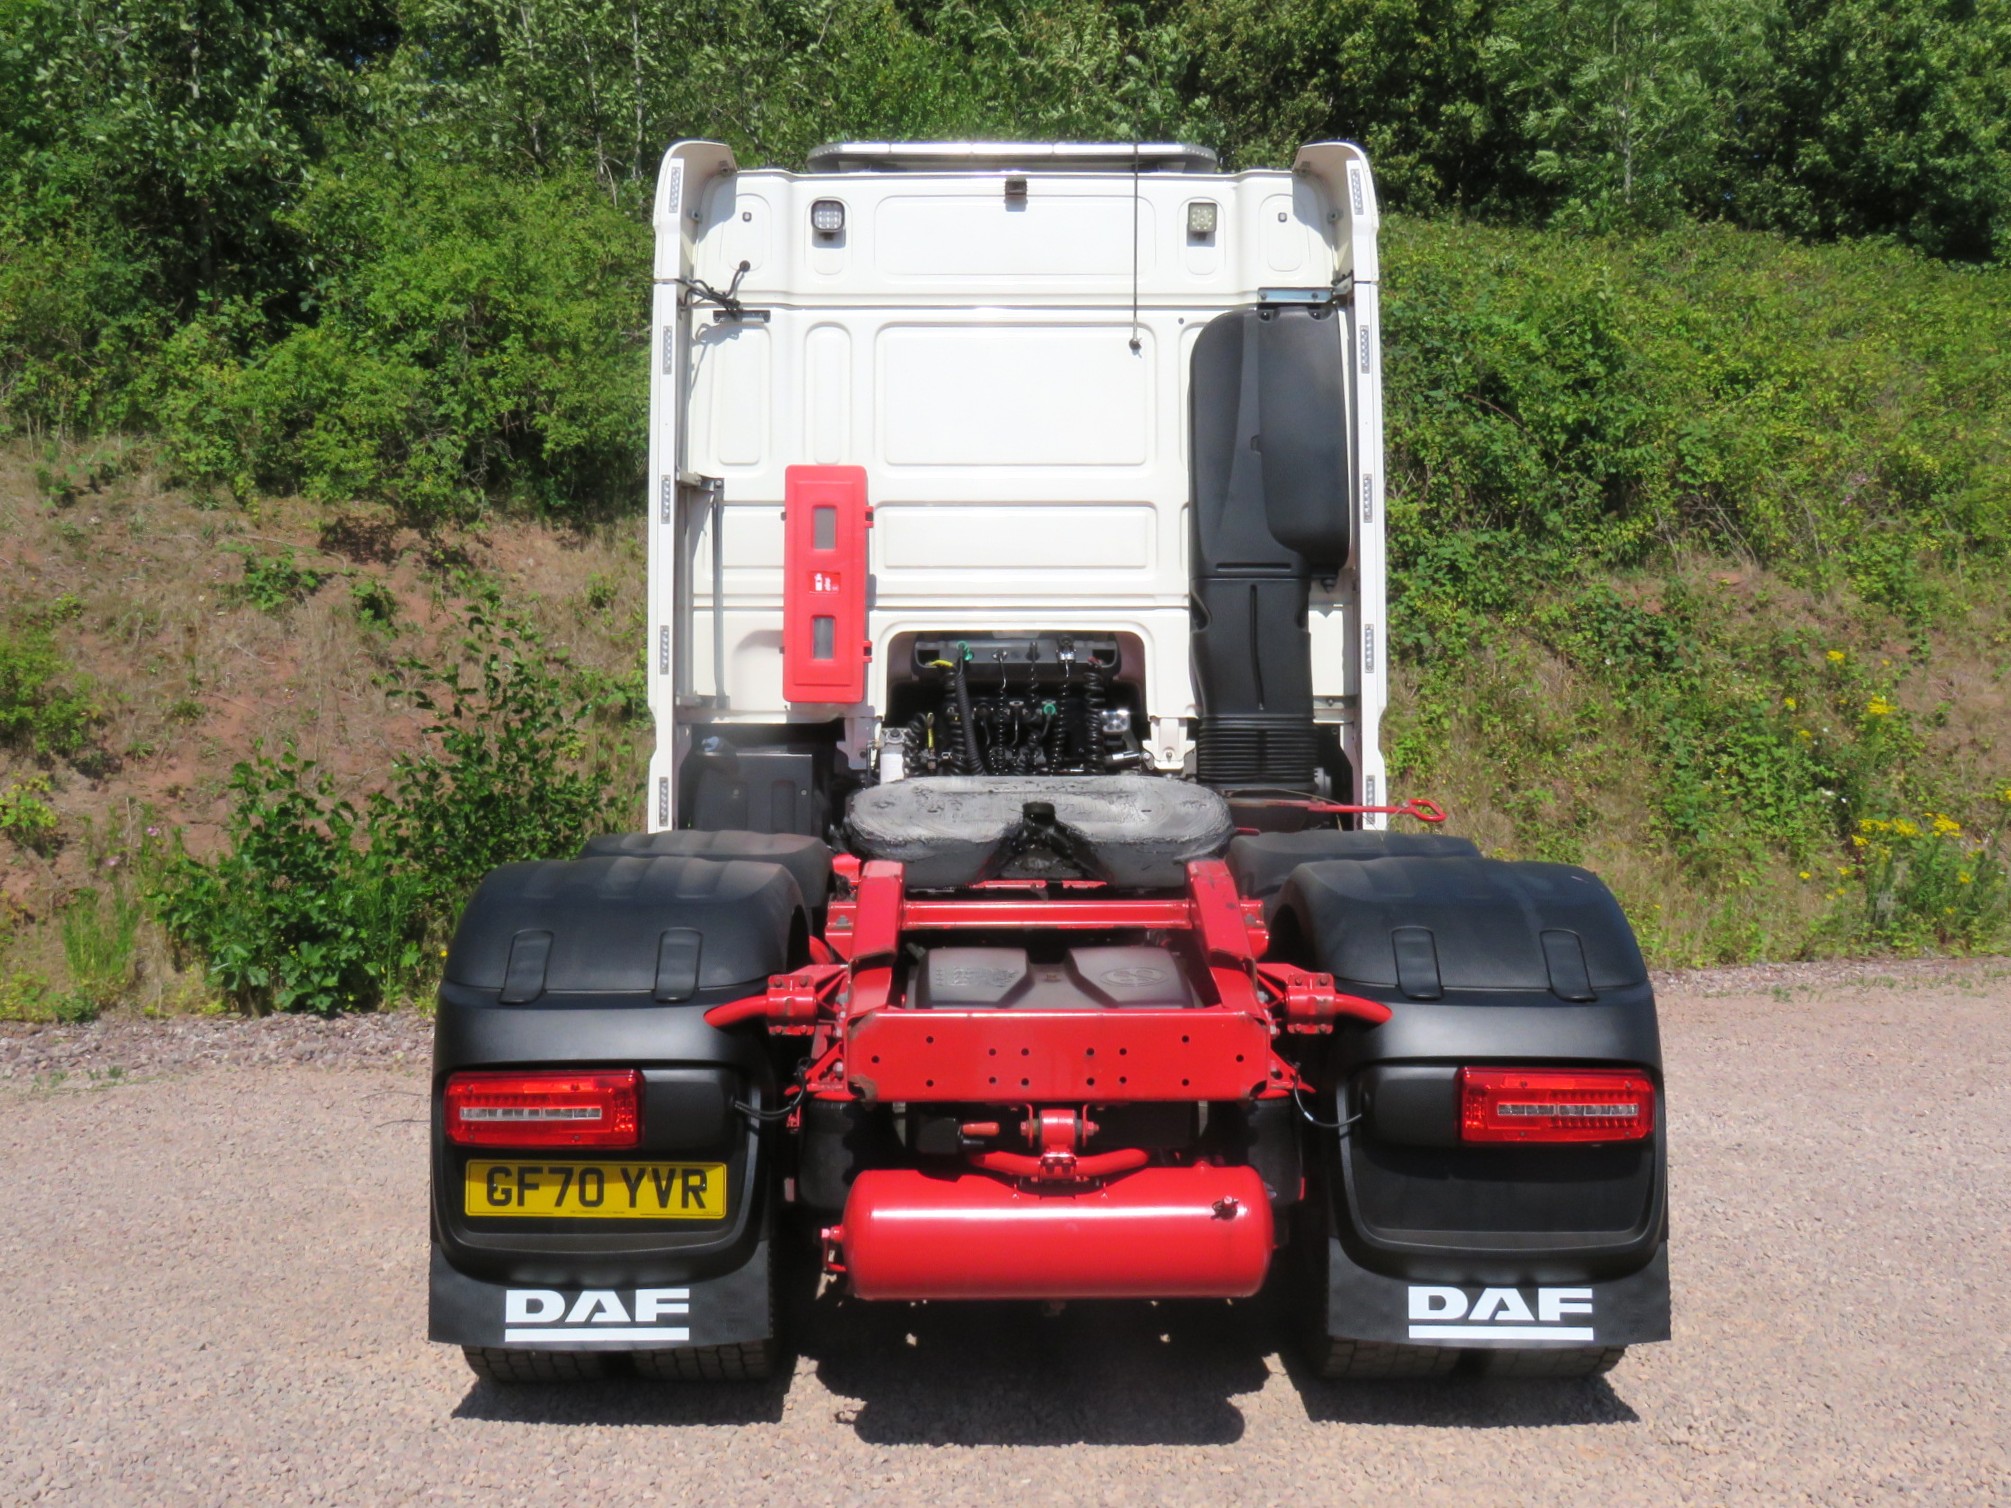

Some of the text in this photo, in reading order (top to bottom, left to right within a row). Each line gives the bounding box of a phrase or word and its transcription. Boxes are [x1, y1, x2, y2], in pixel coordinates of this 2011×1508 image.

[485, 1166, 707, 1209] GF70 YVR
[505, 1288, 690, 1323] DAF
[1407, 1286, 1593, 1322] DAF
